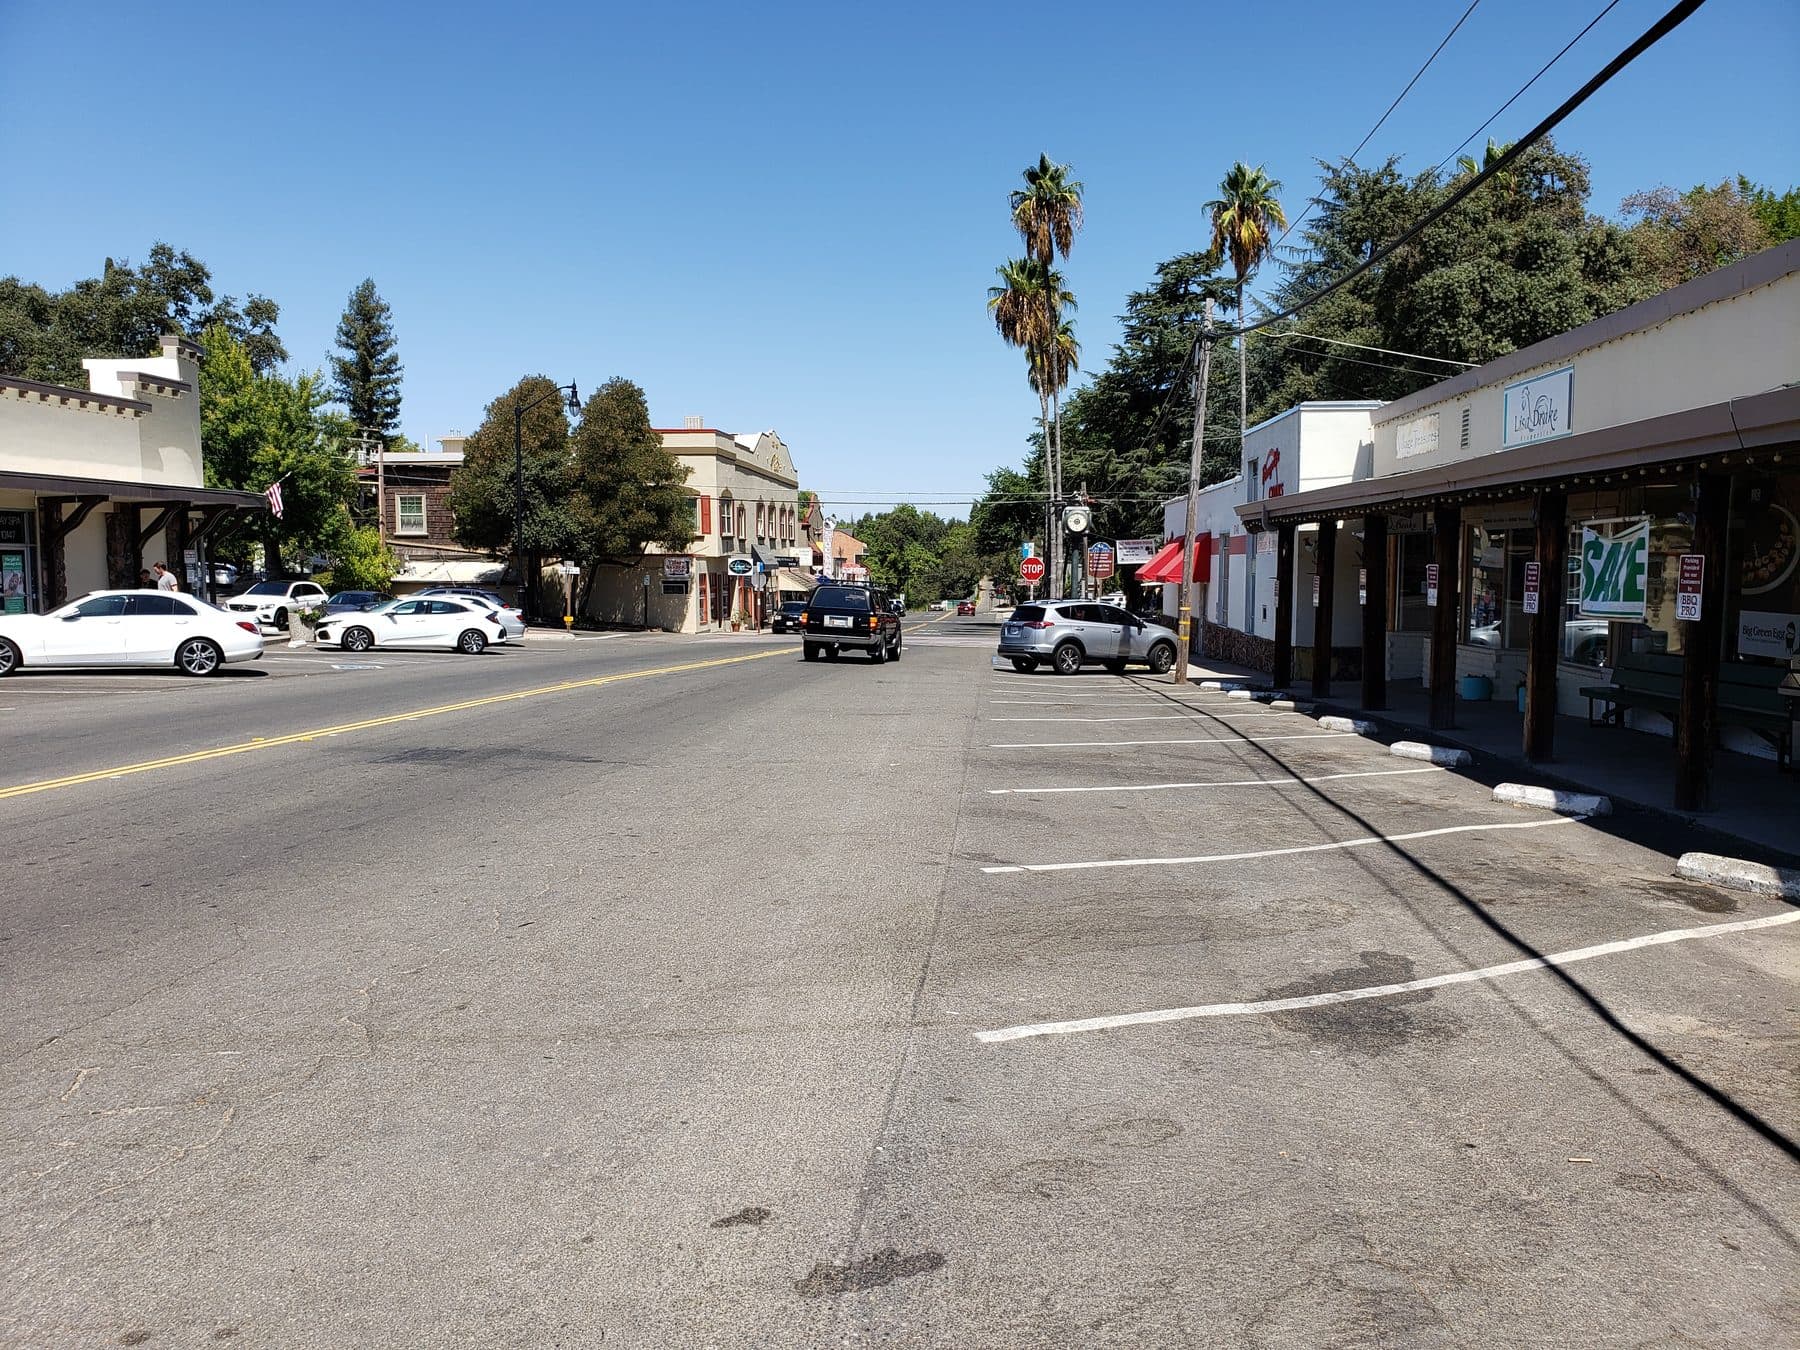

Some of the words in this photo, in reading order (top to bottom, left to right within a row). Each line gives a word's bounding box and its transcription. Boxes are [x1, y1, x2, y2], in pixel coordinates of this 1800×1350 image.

[1514, 415, 1534, 432] Lisa
[1533, 402, 1558, 431] Drake
[1023, 564, 1042, 574] STOP
[1583, 537, 1645, 602] SALE
[1682, 595, 1697, 605] BBQ
[1681, 605, 1696, 616] PRO
